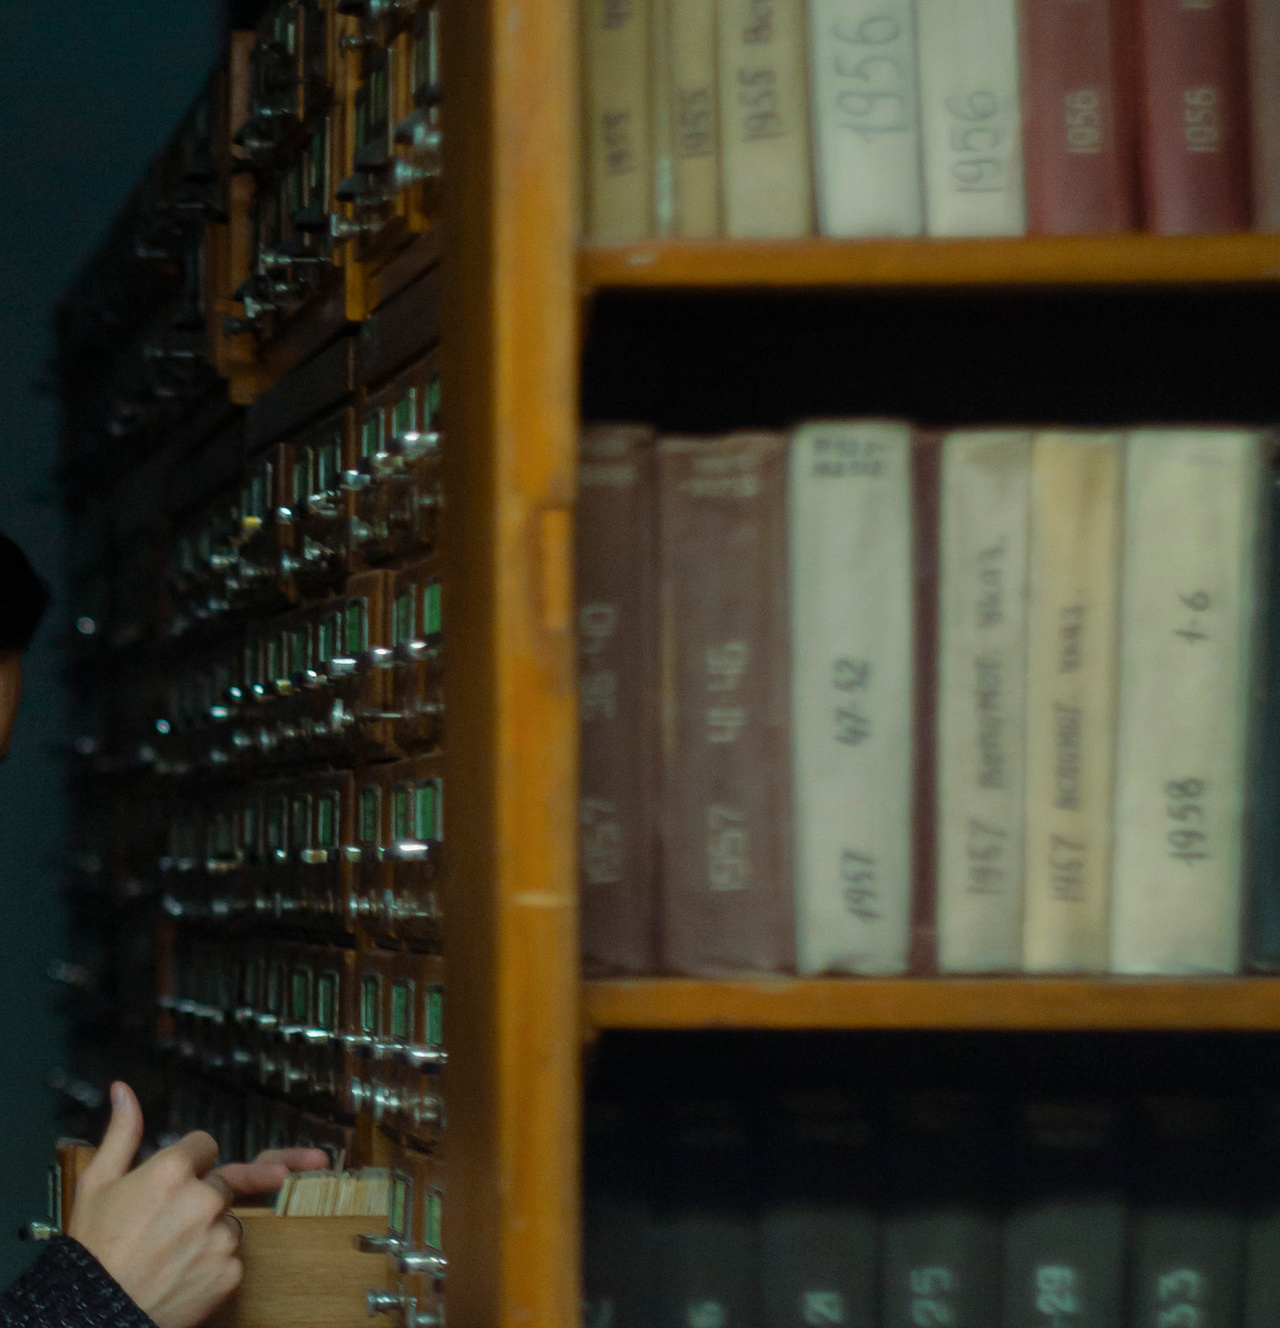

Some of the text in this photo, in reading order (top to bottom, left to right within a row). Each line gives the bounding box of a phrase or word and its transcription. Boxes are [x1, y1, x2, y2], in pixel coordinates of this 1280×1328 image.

[833, 13, 908, 145] 1956
[953, 89, 1003, 196] 1956
[1065, 88, 1098, 155] 1956
[1184, 87, 1218, 154] 1956
[1165, 589, 1212, 868] 1958 1-6
[708, 804, 752, 891] 1957
[841, 850, 880, 920] 1957
[965, 818, 1007, 897] 1957
[1050, 833, 1089, 903] 1957
